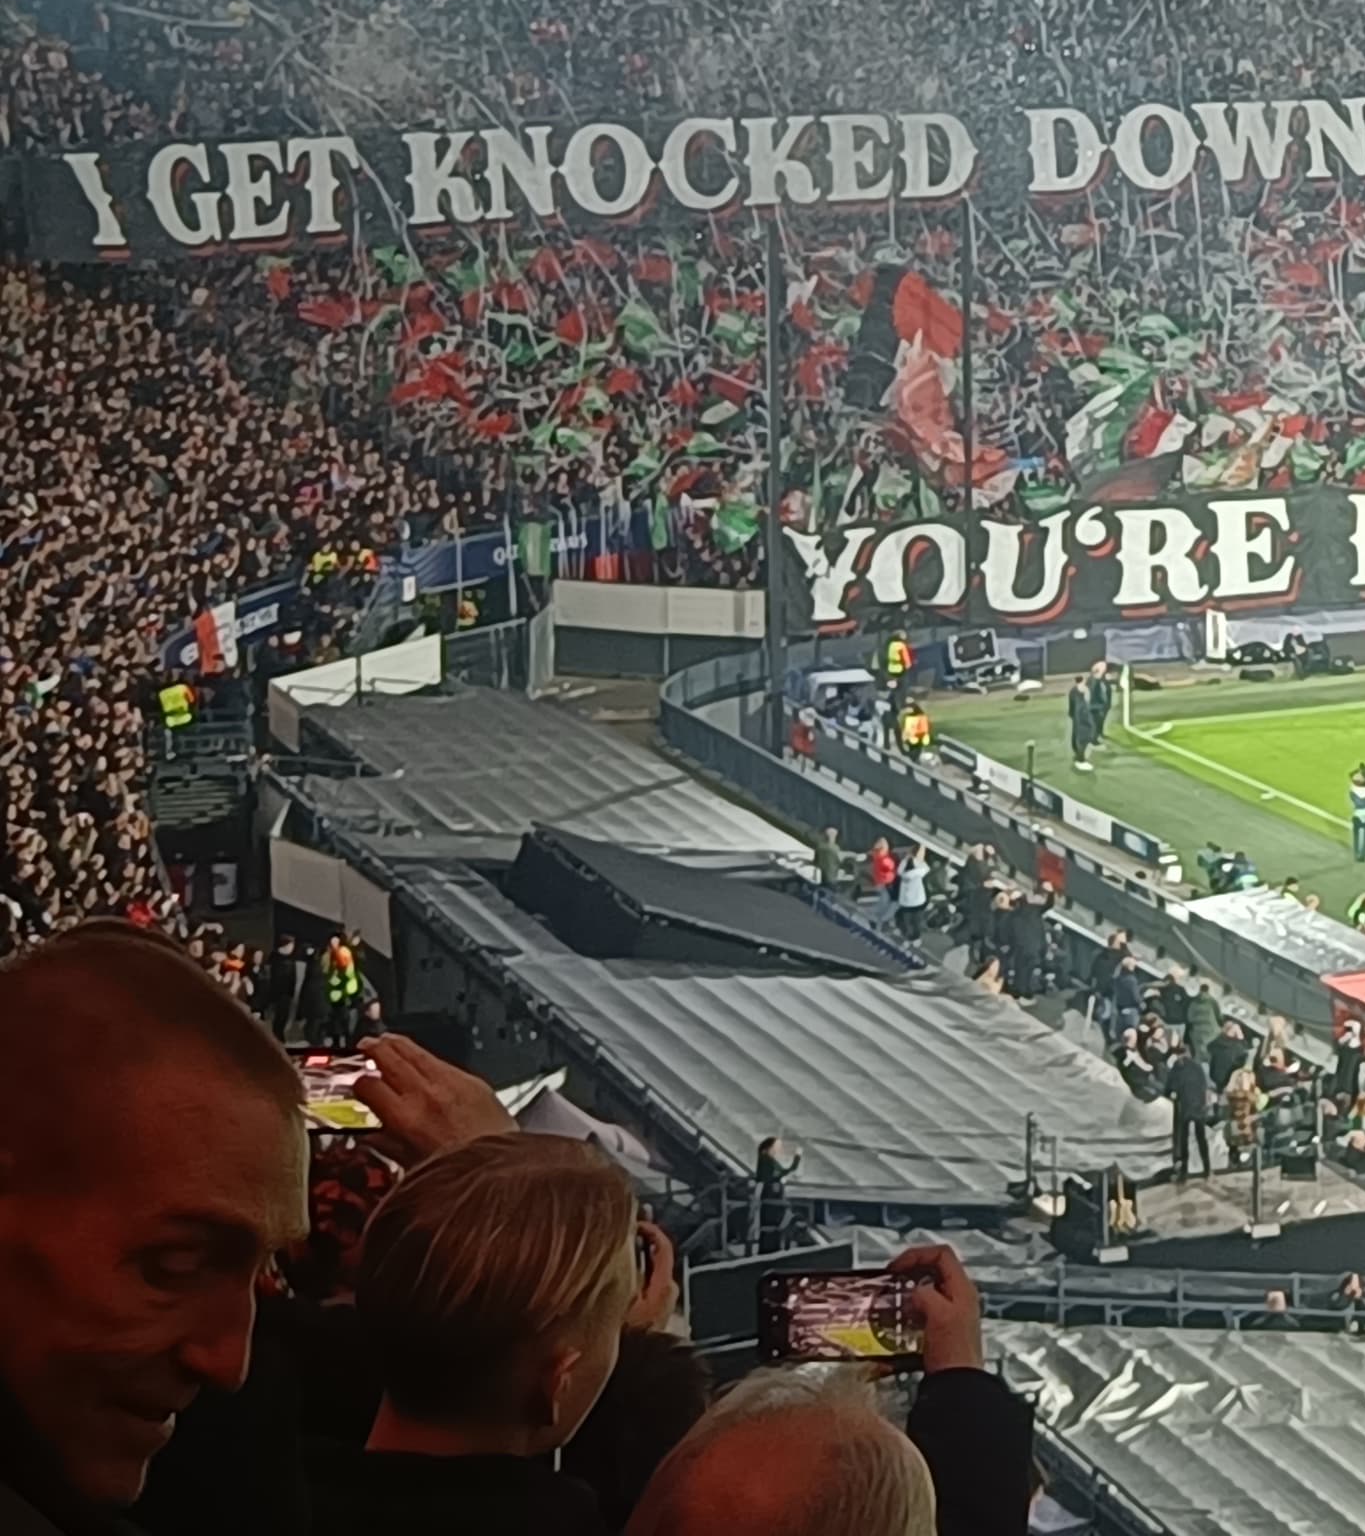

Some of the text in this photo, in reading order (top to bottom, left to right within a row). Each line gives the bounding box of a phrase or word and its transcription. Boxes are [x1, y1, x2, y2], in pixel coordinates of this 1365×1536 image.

[64, 153, 127, 246] I
[146, 136, 360, 245] GET
[404, 114, 978, 224] KNOCKED
